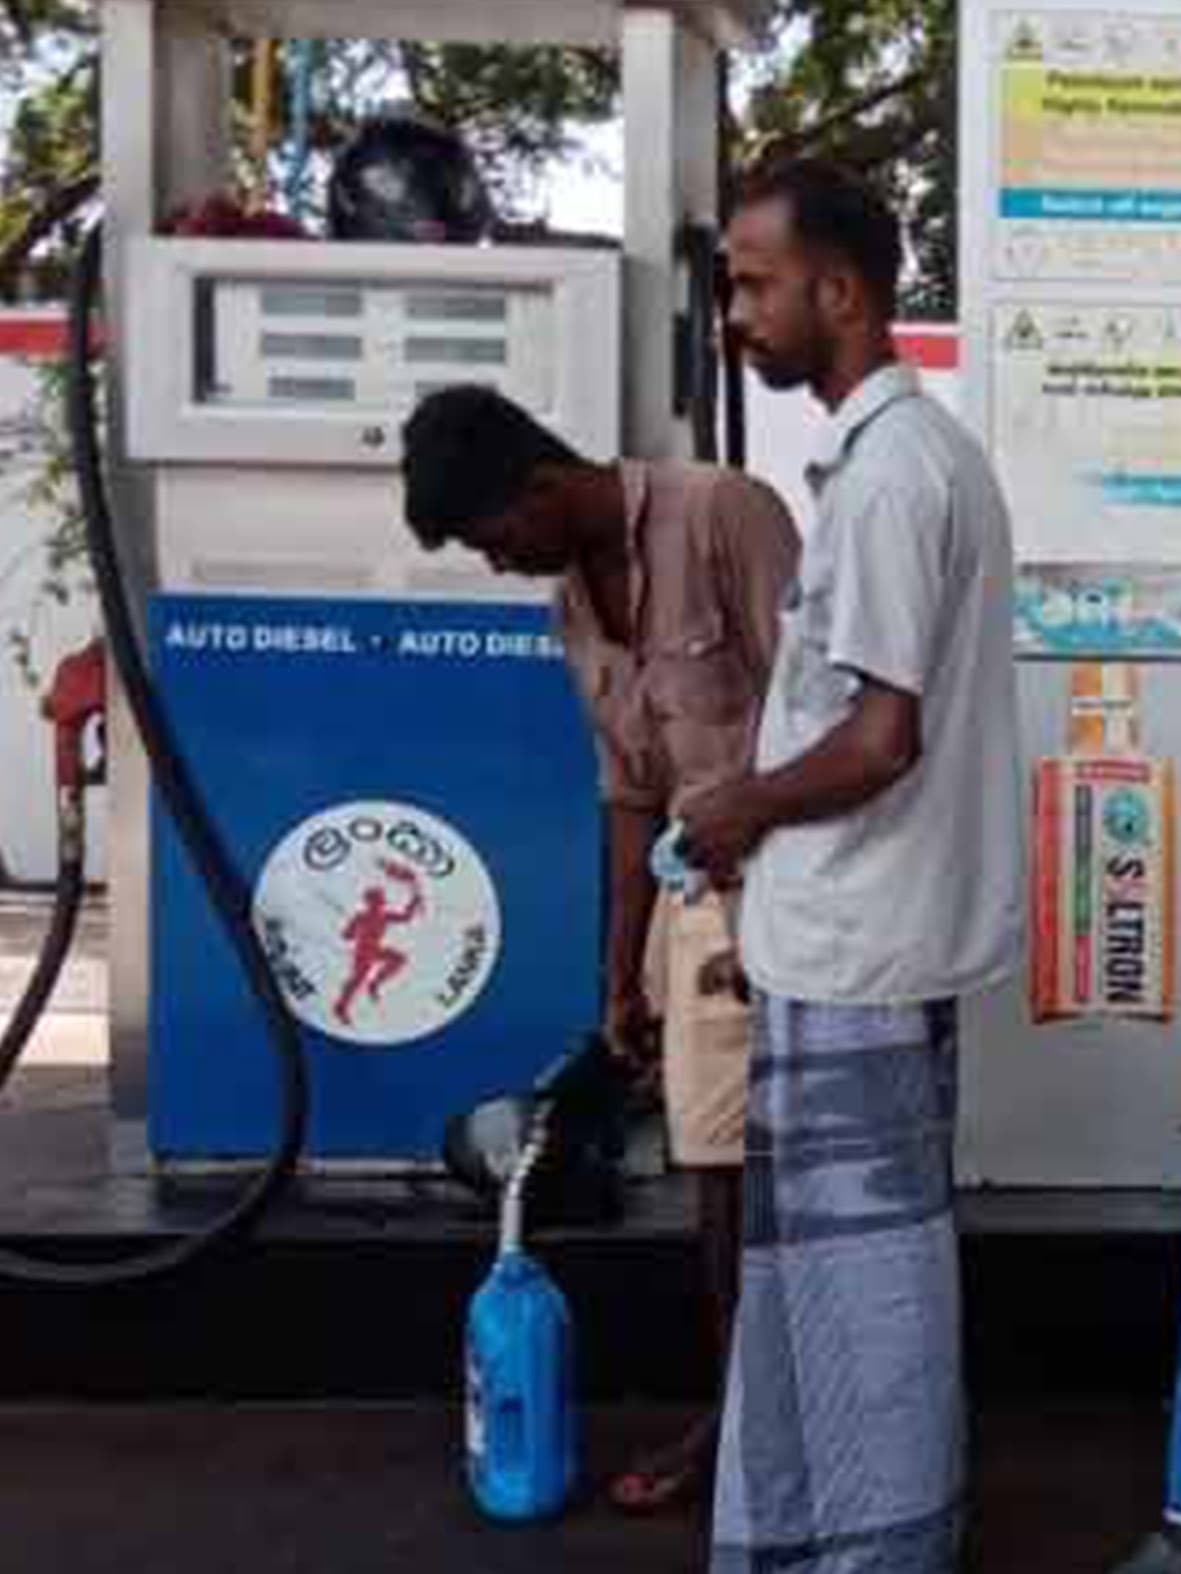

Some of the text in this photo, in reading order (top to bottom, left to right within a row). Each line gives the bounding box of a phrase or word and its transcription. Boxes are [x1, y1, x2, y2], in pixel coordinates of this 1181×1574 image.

[166, 621, 356, 653] AUTO DIESEL
[399, 630, 480, 657] AUTO
